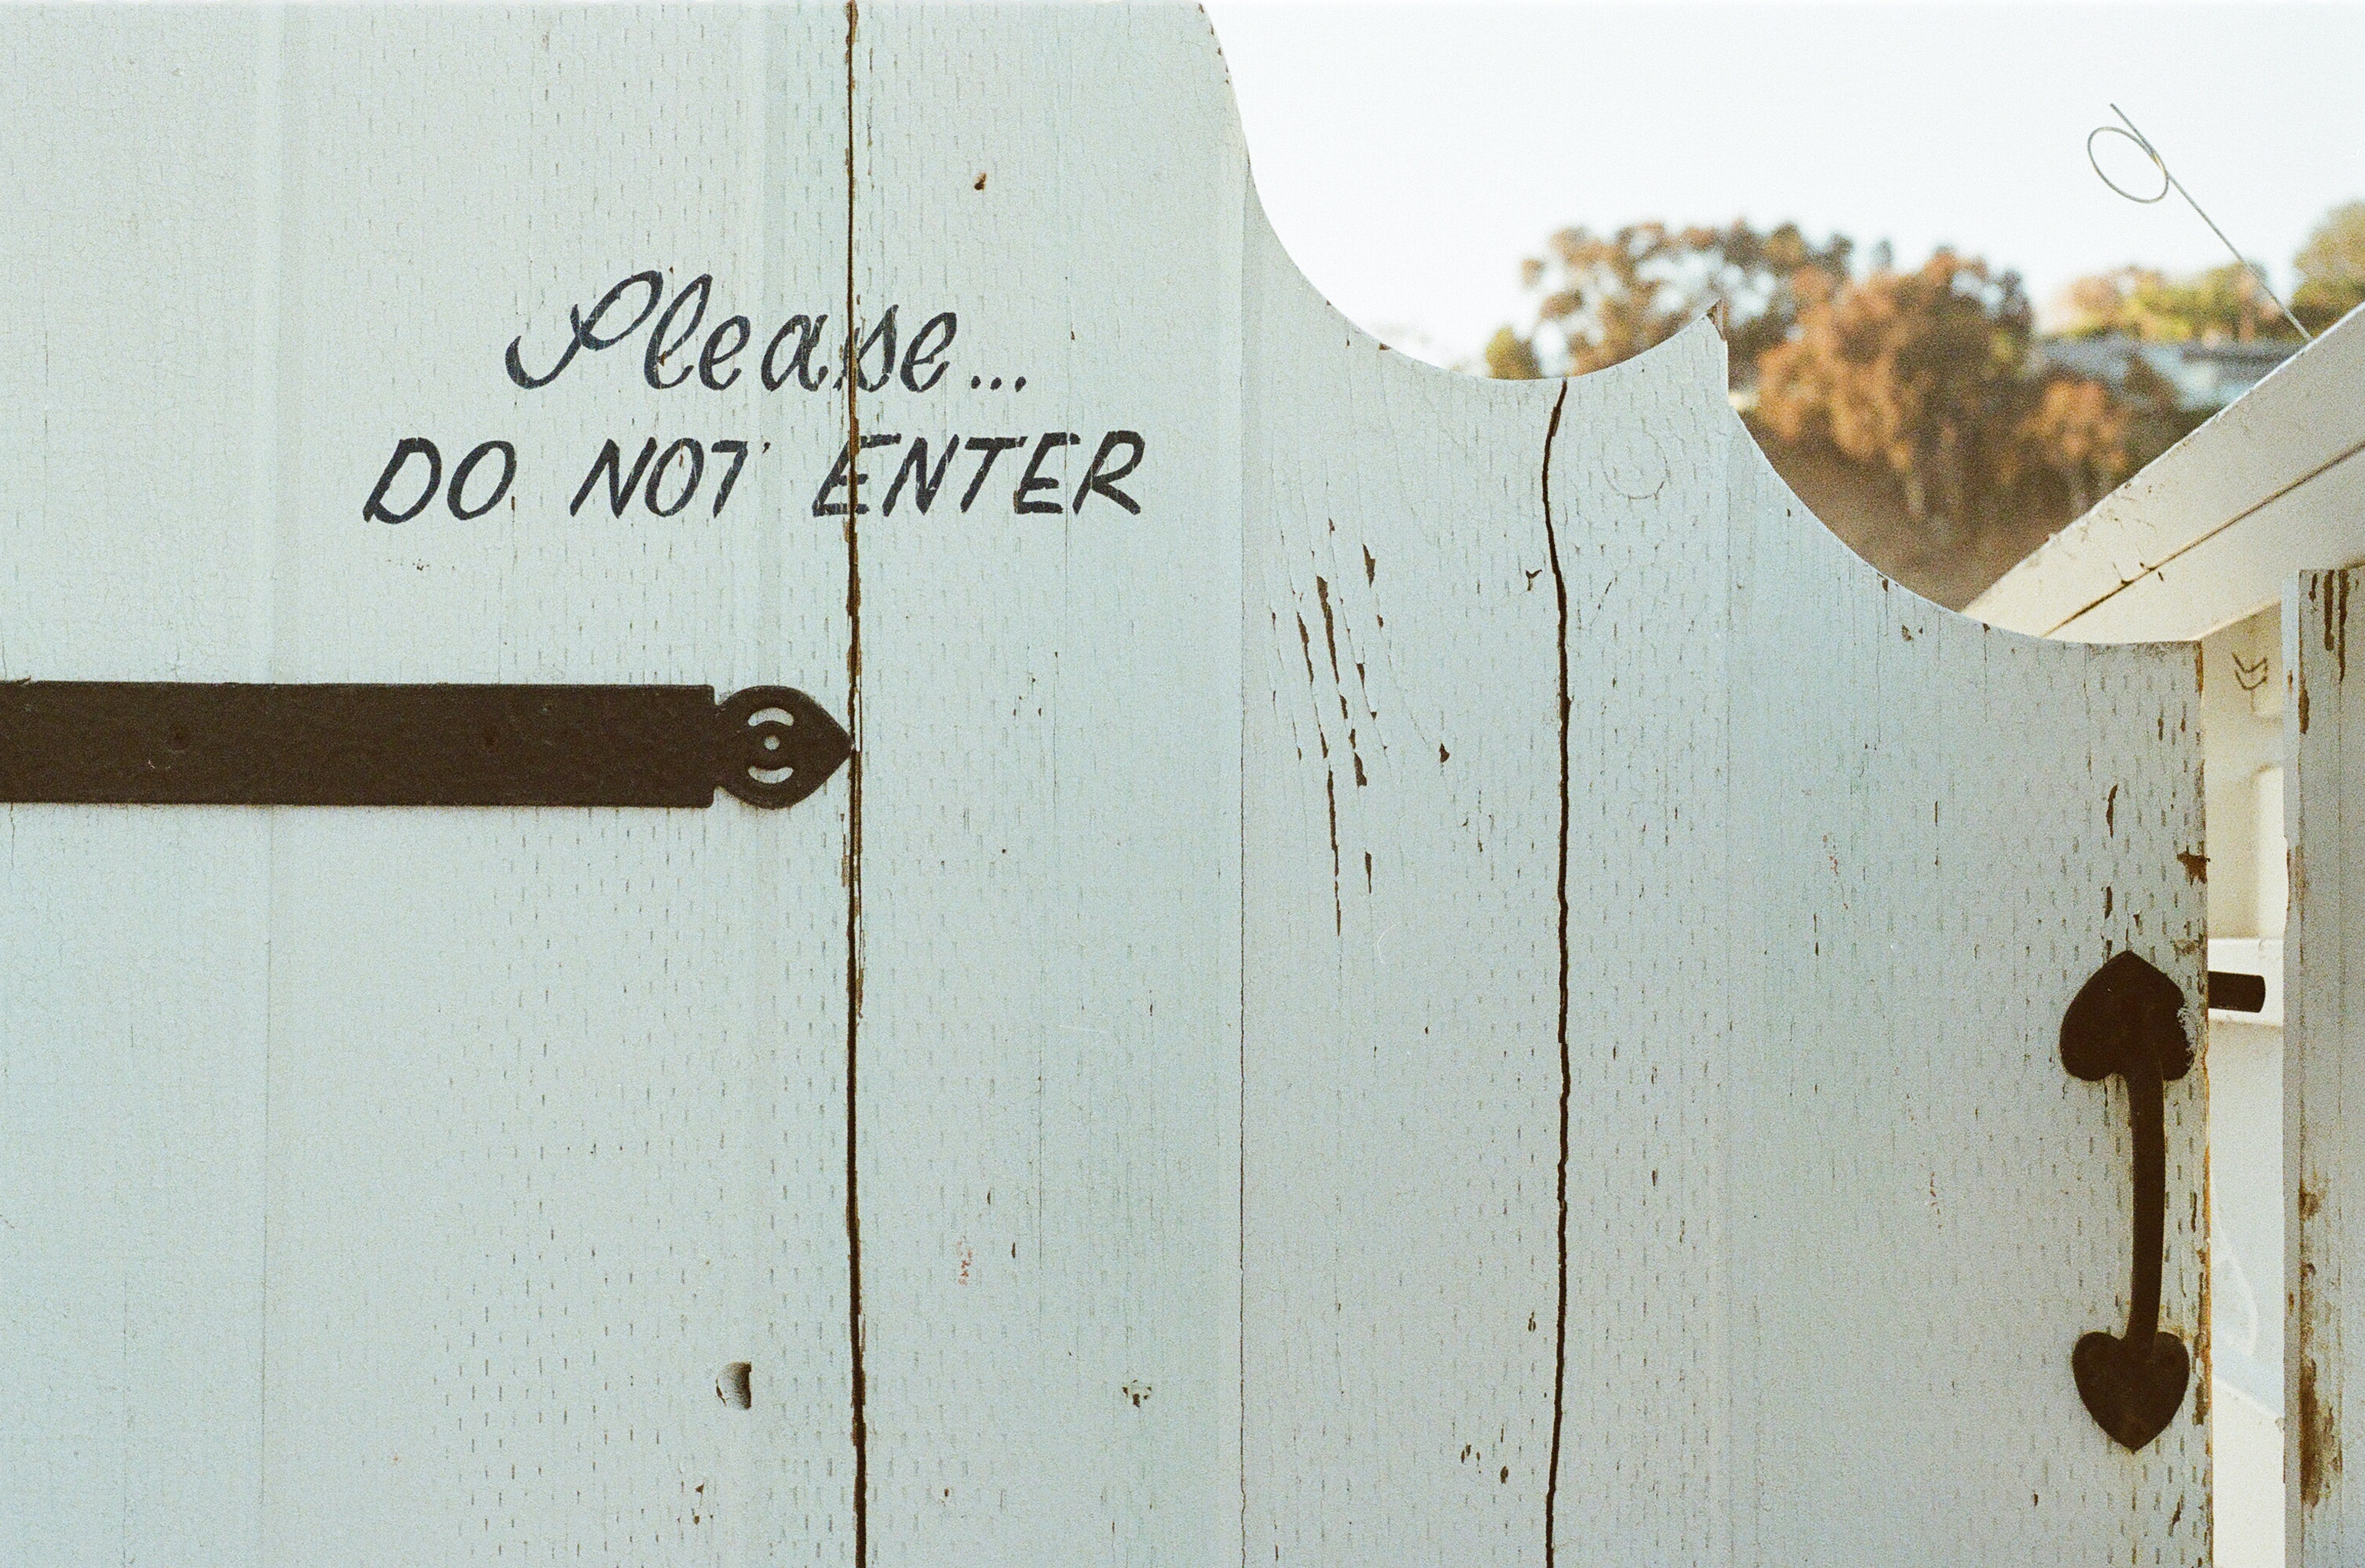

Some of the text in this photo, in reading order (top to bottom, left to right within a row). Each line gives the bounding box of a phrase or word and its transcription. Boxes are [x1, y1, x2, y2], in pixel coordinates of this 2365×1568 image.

[505, 270, 1027, 392] Please...
[362, 430, 1145, 524] DO NOT ENTER
